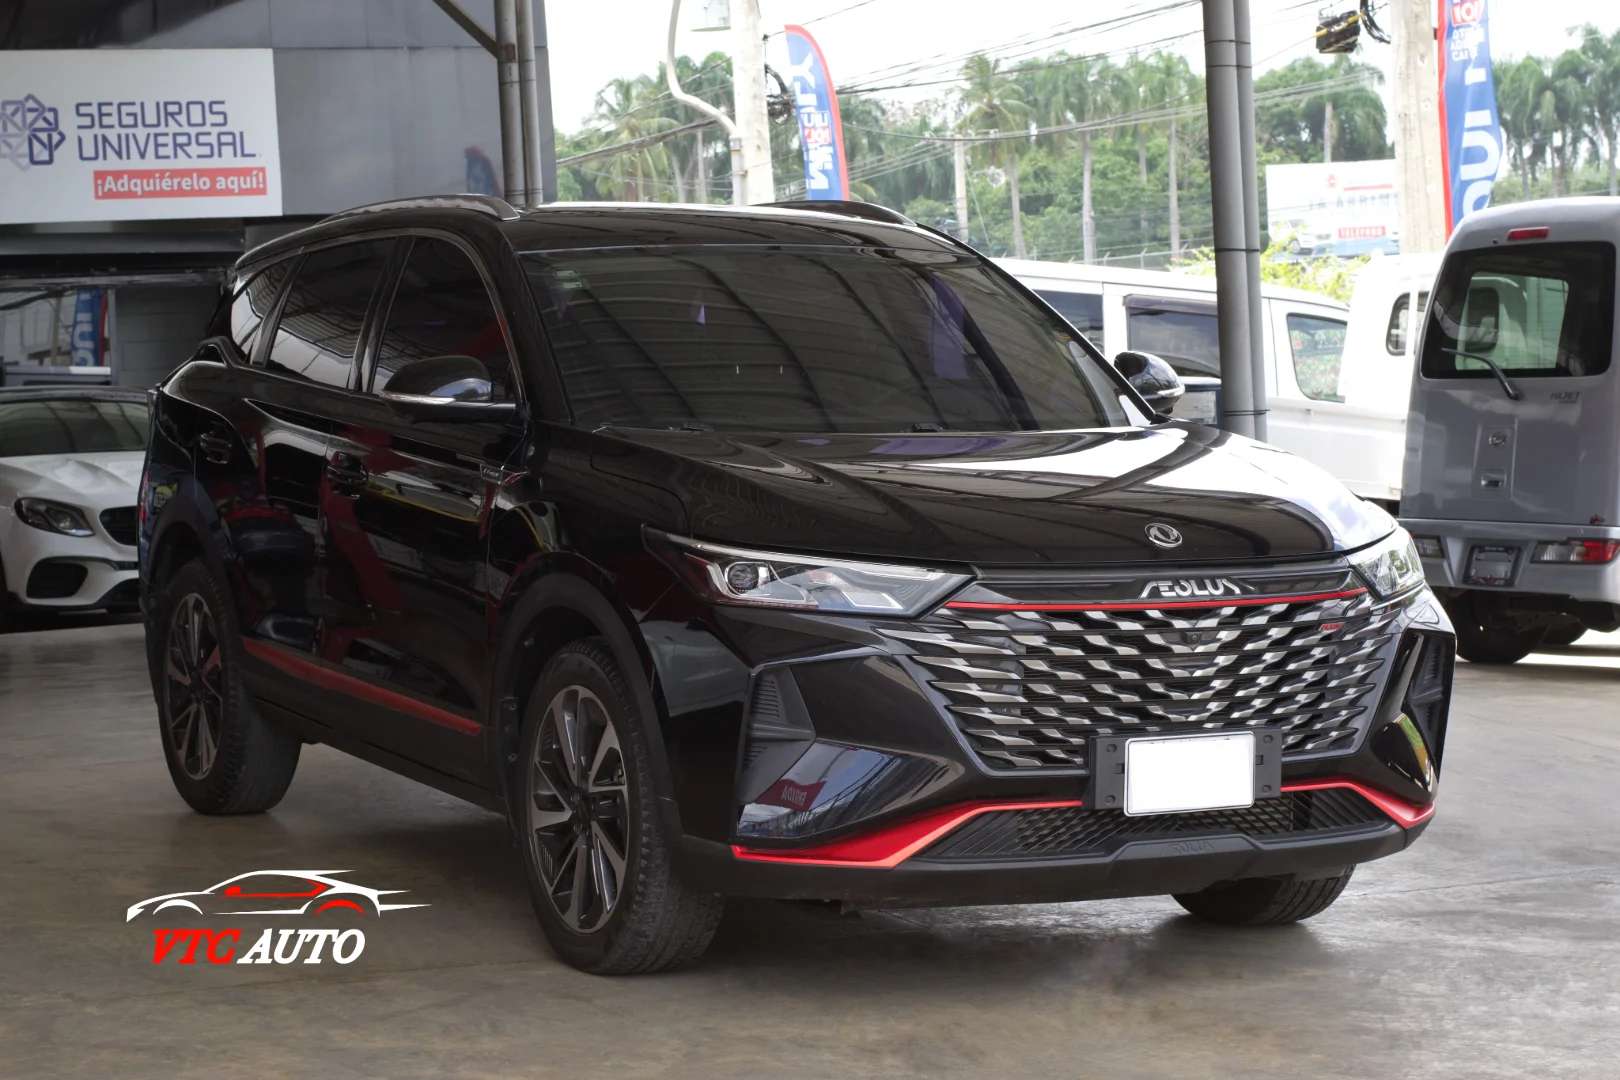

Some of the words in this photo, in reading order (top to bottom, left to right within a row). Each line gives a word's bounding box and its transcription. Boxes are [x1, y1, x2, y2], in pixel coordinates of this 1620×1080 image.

[75, 100, 228, 129] SEGUROS
[77, 131, 256, 161] UNIVERSAL
[97, 172, 210, 196] ¡Adquiérelo
[216, 170, 265, 195] aquí!
[1138, 578, 1241, 599] AEOLUS
